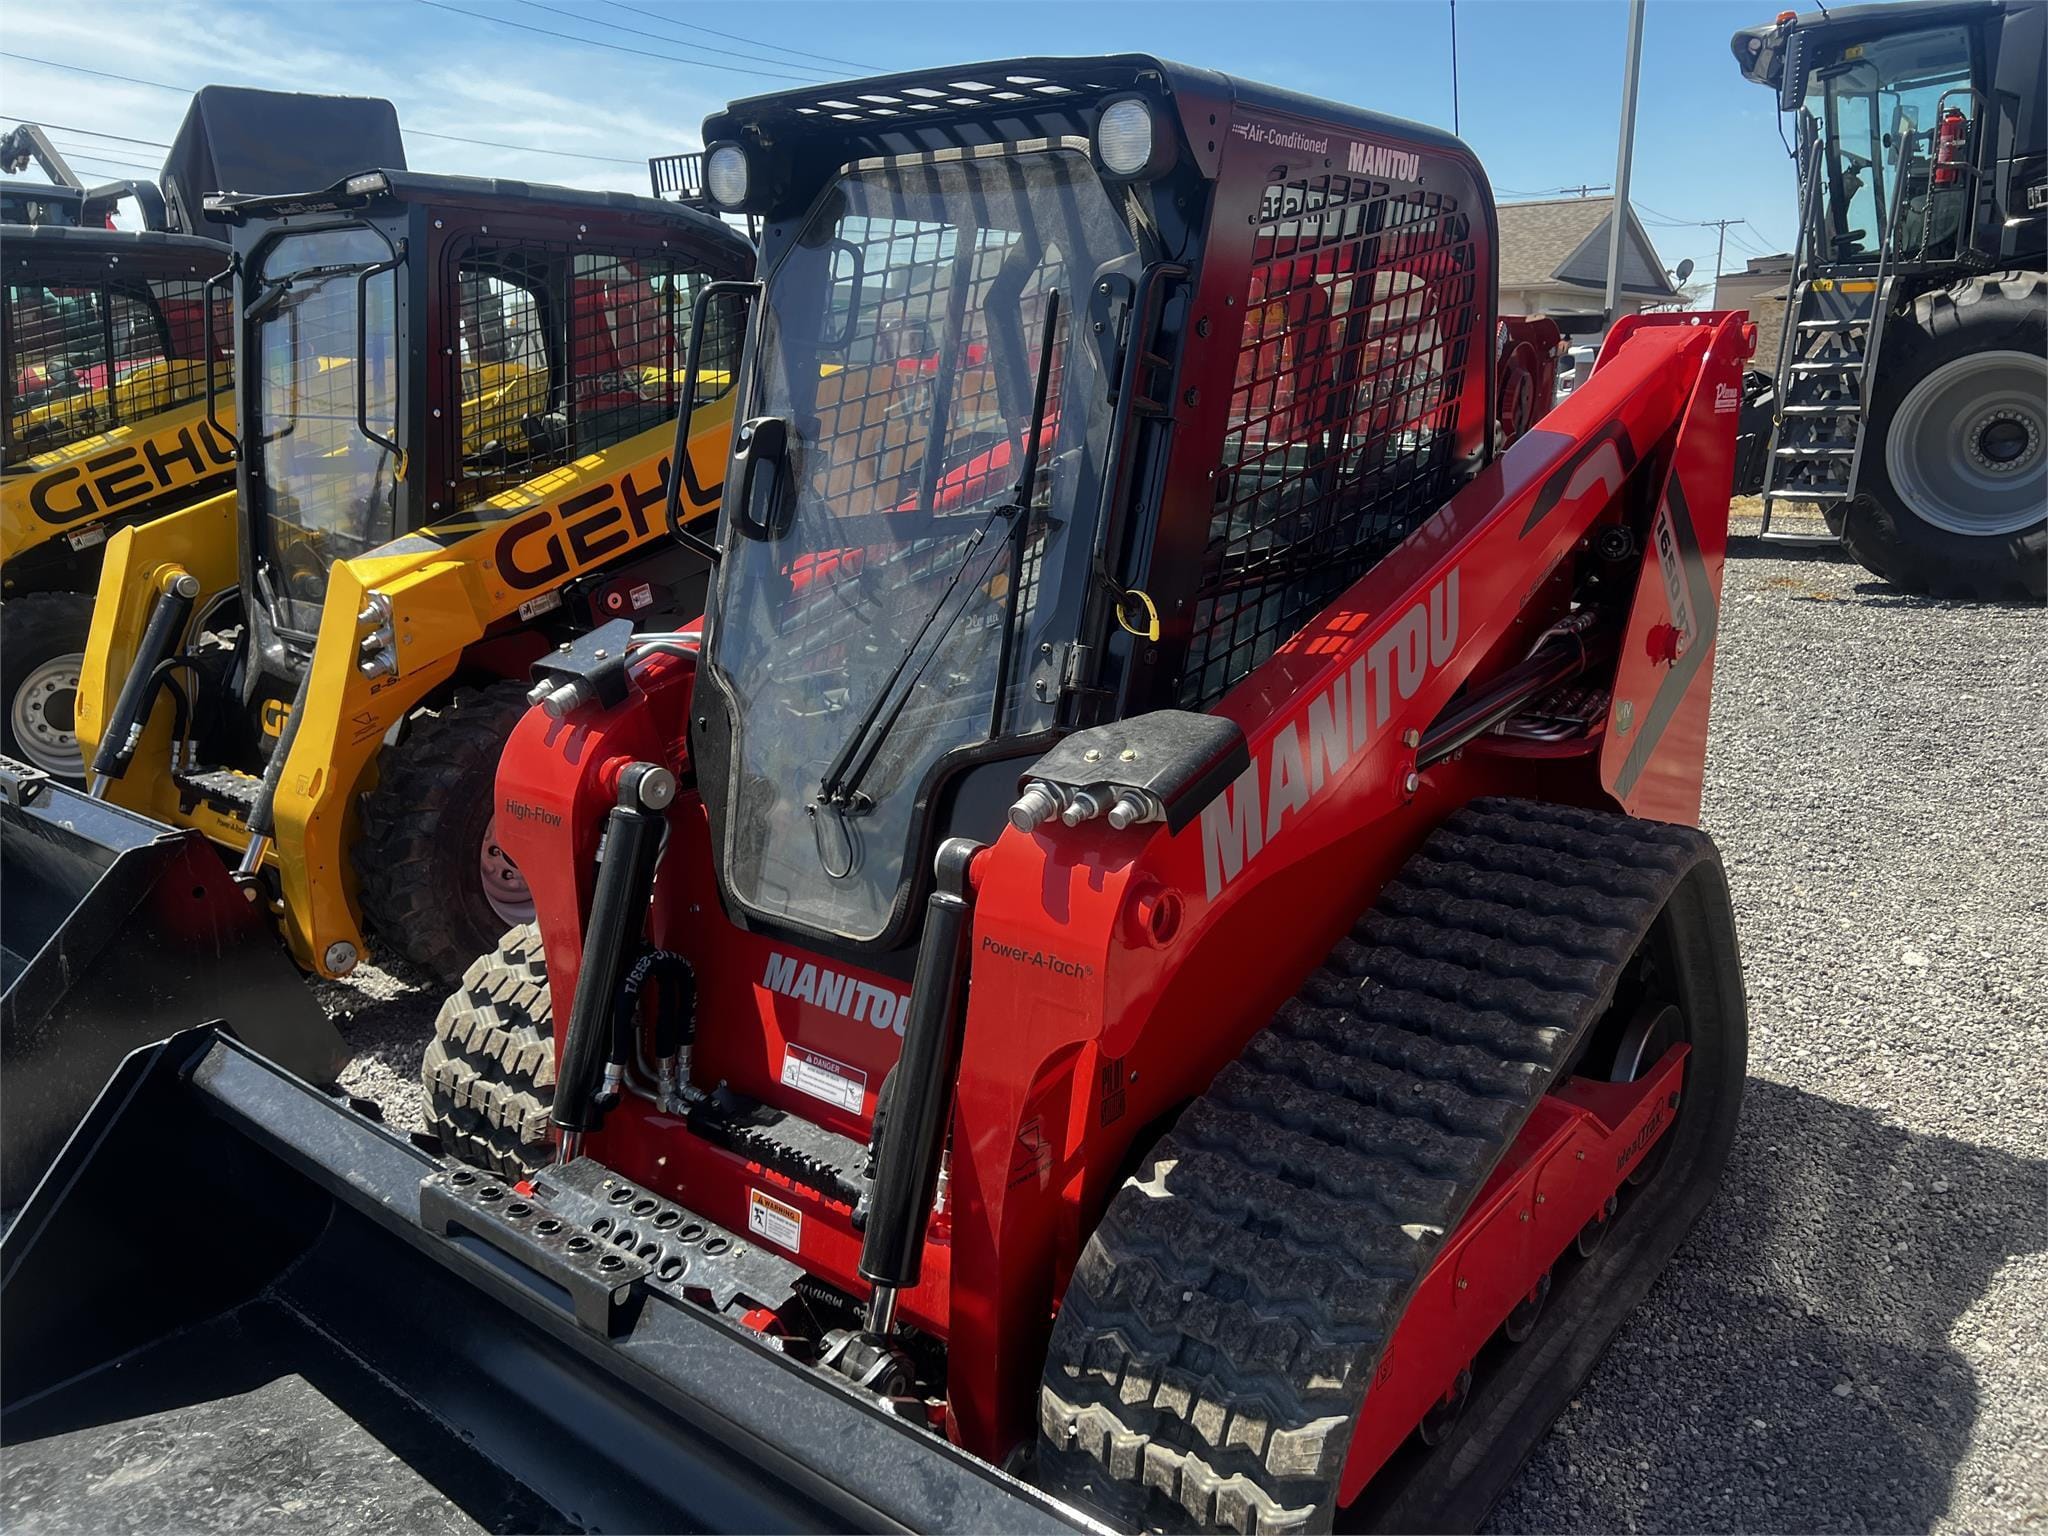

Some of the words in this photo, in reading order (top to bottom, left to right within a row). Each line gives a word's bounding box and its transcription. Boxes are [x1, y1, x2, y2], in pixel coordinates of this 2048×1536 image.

[1248, 124, 1328, 154] Air-Conditioned
[1348, 141, 1420, 182] MANITOU
[30, 420, 237, 524] GEHL
[495, 448, 724, 590] GEHL
[1654, 510, 1682, 598] 1650
[1200, 565, 1460, 904] MANITOU
[505, 798, 562, 827] High-Flow
[813, 1056, 840, 1074] DANGER
[765, 1199, 795, 1219] WARNING
